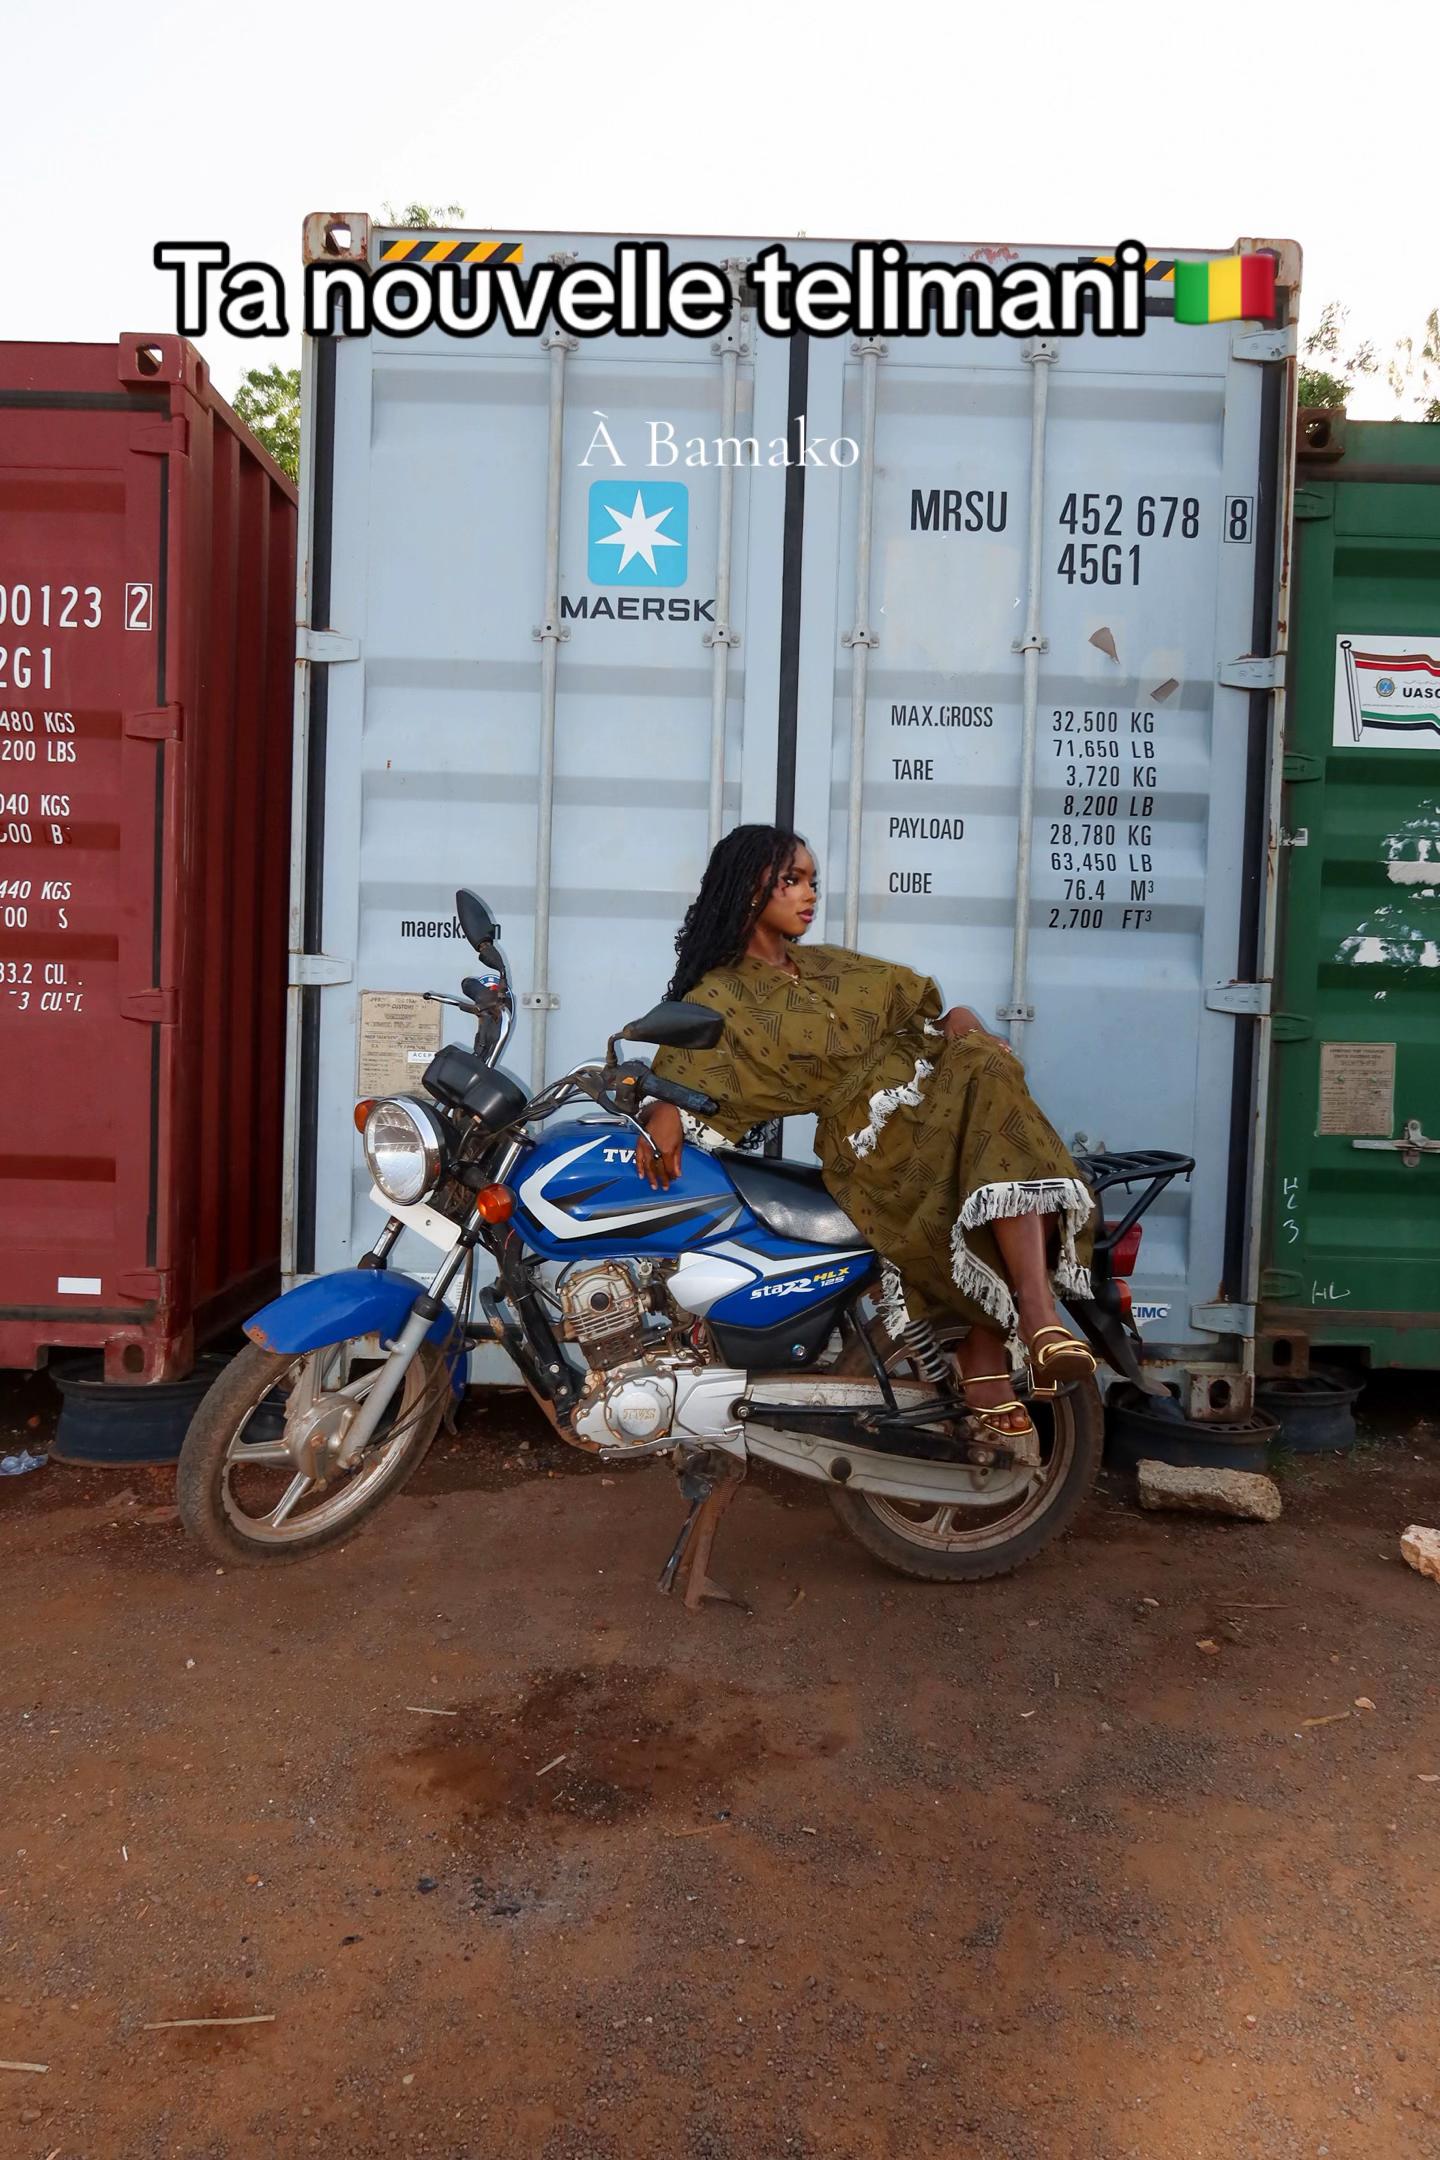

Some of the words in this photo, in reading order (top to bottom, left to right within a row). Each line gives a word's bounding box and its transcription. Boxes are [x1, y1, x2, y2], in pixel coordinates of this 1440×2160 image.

[911, 489, 1008, 532] MRSU
[1059, 493, 1123, 536] 452
[1137, 496, 1200, 539] 678
[1230, 499, 1248, 541] 8
[1057, 543, 1140, 586] 45G1
[129, 587, 148, 628] 2
[560, 595, 716, 622] MAERSK
[44, 711, 76, 733] KGS
[891, 704, 993, 728] MAX.GROSS
[1053, 711, 1118, 734] 32,500
[1130, 712, 1155, 734] KG
[47, 741, 77, 762] LBS
[1053, 739, 1119, 759] 71,650
[1132, 741, 1155, 760] LB
[892, 759, 934, 781] TARE
[1066, 765, 1120, 788] 3,720
[1133, 766, 1157, 788] KG
[41, 794, 70, 816] KGS
[1064, 795, 1118, 818] 8,200
[1129, 796, 1154, 817] LB
[889, 817, 964, 840] PAYLOAD
[1050, 824, 1115, 847] 28,780
[1128, 825, 1152, 847] KG
[1051, 852, 1117, 873] 63,450
[1129, 854, 1153, 873] LB
[41, 881, 73, 900] KGS
[889, 872, 932, 894] CUBE
[1063, 879, 1105, 901] 76.4
[0, 905, 28, 928] 00
[1048, 908, 1103, 930] 2,700
[401, 916, 501, 940] maersk.m
[603, 1148, 637, 1164] TV
[813, 1266, 850, 1282] HLX
[821, 1275, 846, 1288] 125
[623, 1407, 657, 1420] TVS
